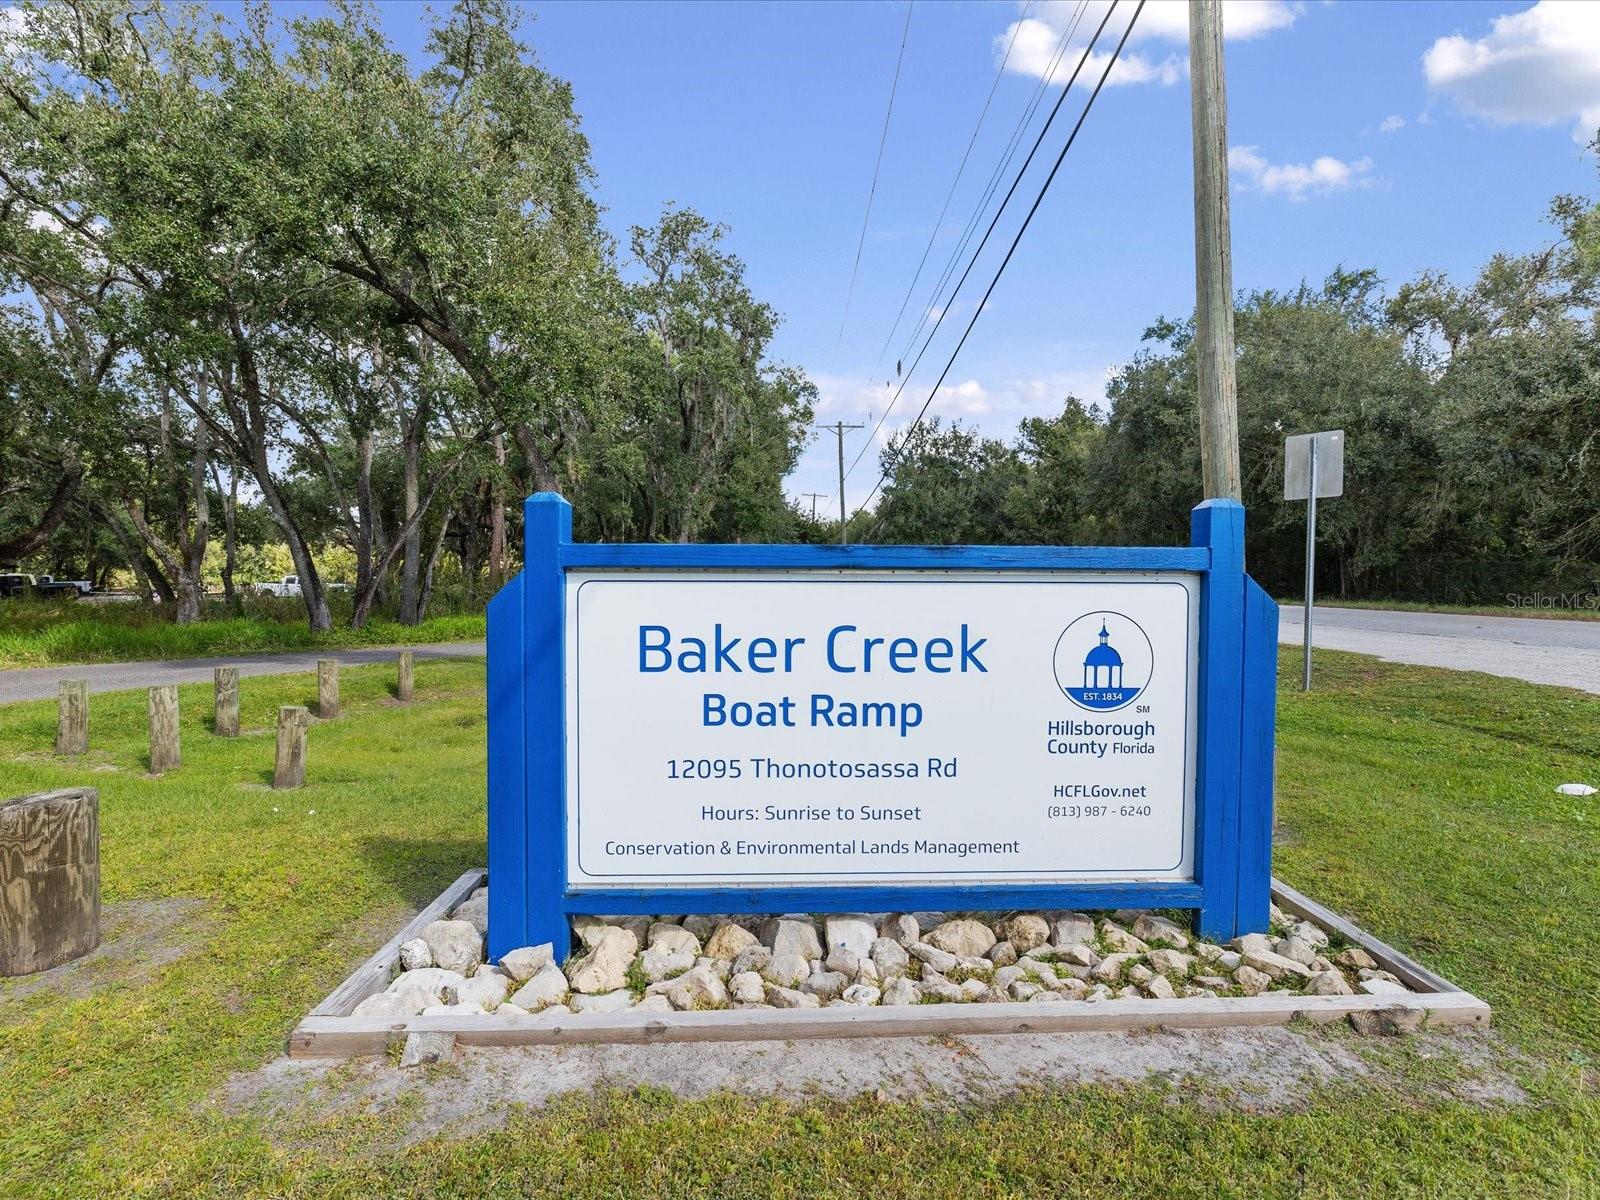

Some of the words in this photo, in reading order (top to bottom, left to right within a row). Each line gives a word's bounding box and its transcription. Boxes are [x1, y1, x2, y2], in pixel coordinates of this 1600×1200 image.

[640, 624, 805, 673] Baker
[827, 624, 989, 673] Creek
[1083, 692, 1100, 701] EST.
[1102, 692, 1123, 701] 1834
[703, 694, 796, 728] Boat
[811, 694, 922, 738] Ramp
[1136, 705, 1151, 714] SM
[1048, 720, 1155, 739] Hillsborough
[1047, 739, 1108, 758] County
[1113, 742, 1155, 754] Florida
[667, 760, 741, 779] 12095
[750, 758, 918, 779] Thonotosassa
[928, 758, 957, 778] Rd
[1053, 785, 1147, 798] HCFLGov.net
[701, 806, 759, 821] Hours:
[766, 806, 830, 821] Sunrise
[836, 807, 855, 821] to
[861, 806, 922, 821] Sunset
[1047, 805, 1081, 819] (813)
[1085, 806, 1107, 817] 987
[1120, 806, 1152, 817] 6240
[606, 840, 715, 856] Conservation
[720, 841, 732, 856] &
[737, 840, 856, 855] Environmental
[862, 840, 910, 855] Lands
[915, 840, 1020, 858] Management
